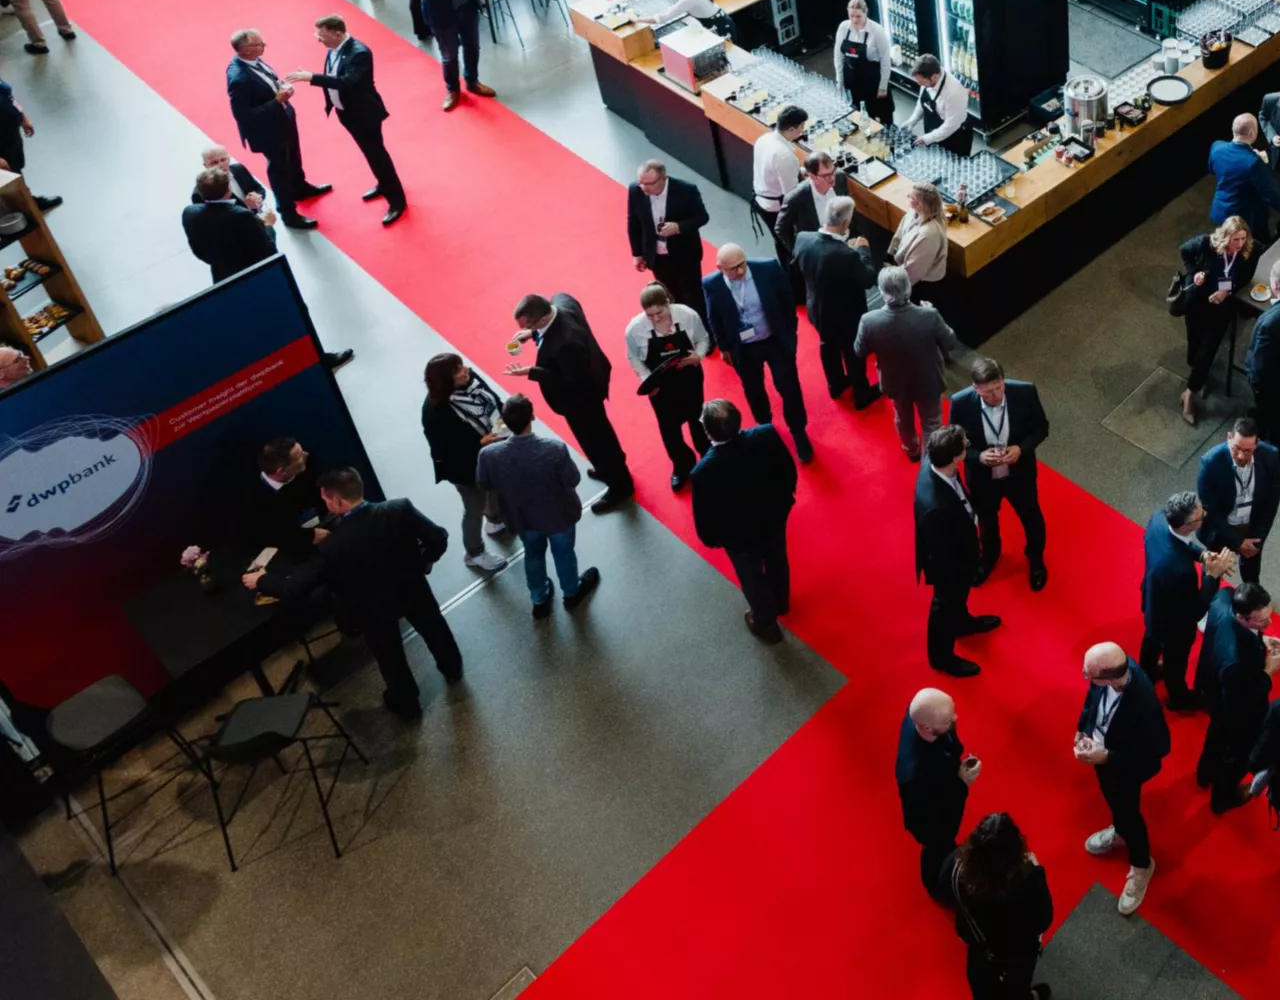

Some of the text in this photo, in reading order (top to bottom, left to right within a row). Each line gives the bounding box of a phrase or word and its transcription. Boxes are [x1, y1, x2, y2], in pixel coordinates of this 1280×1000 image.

[168, 359, 285, 425] Customer Insight der dwpbank
[187, 379, 263, 424] Wertpapierplattform
[26, 453, 117, 508] dwpbank
